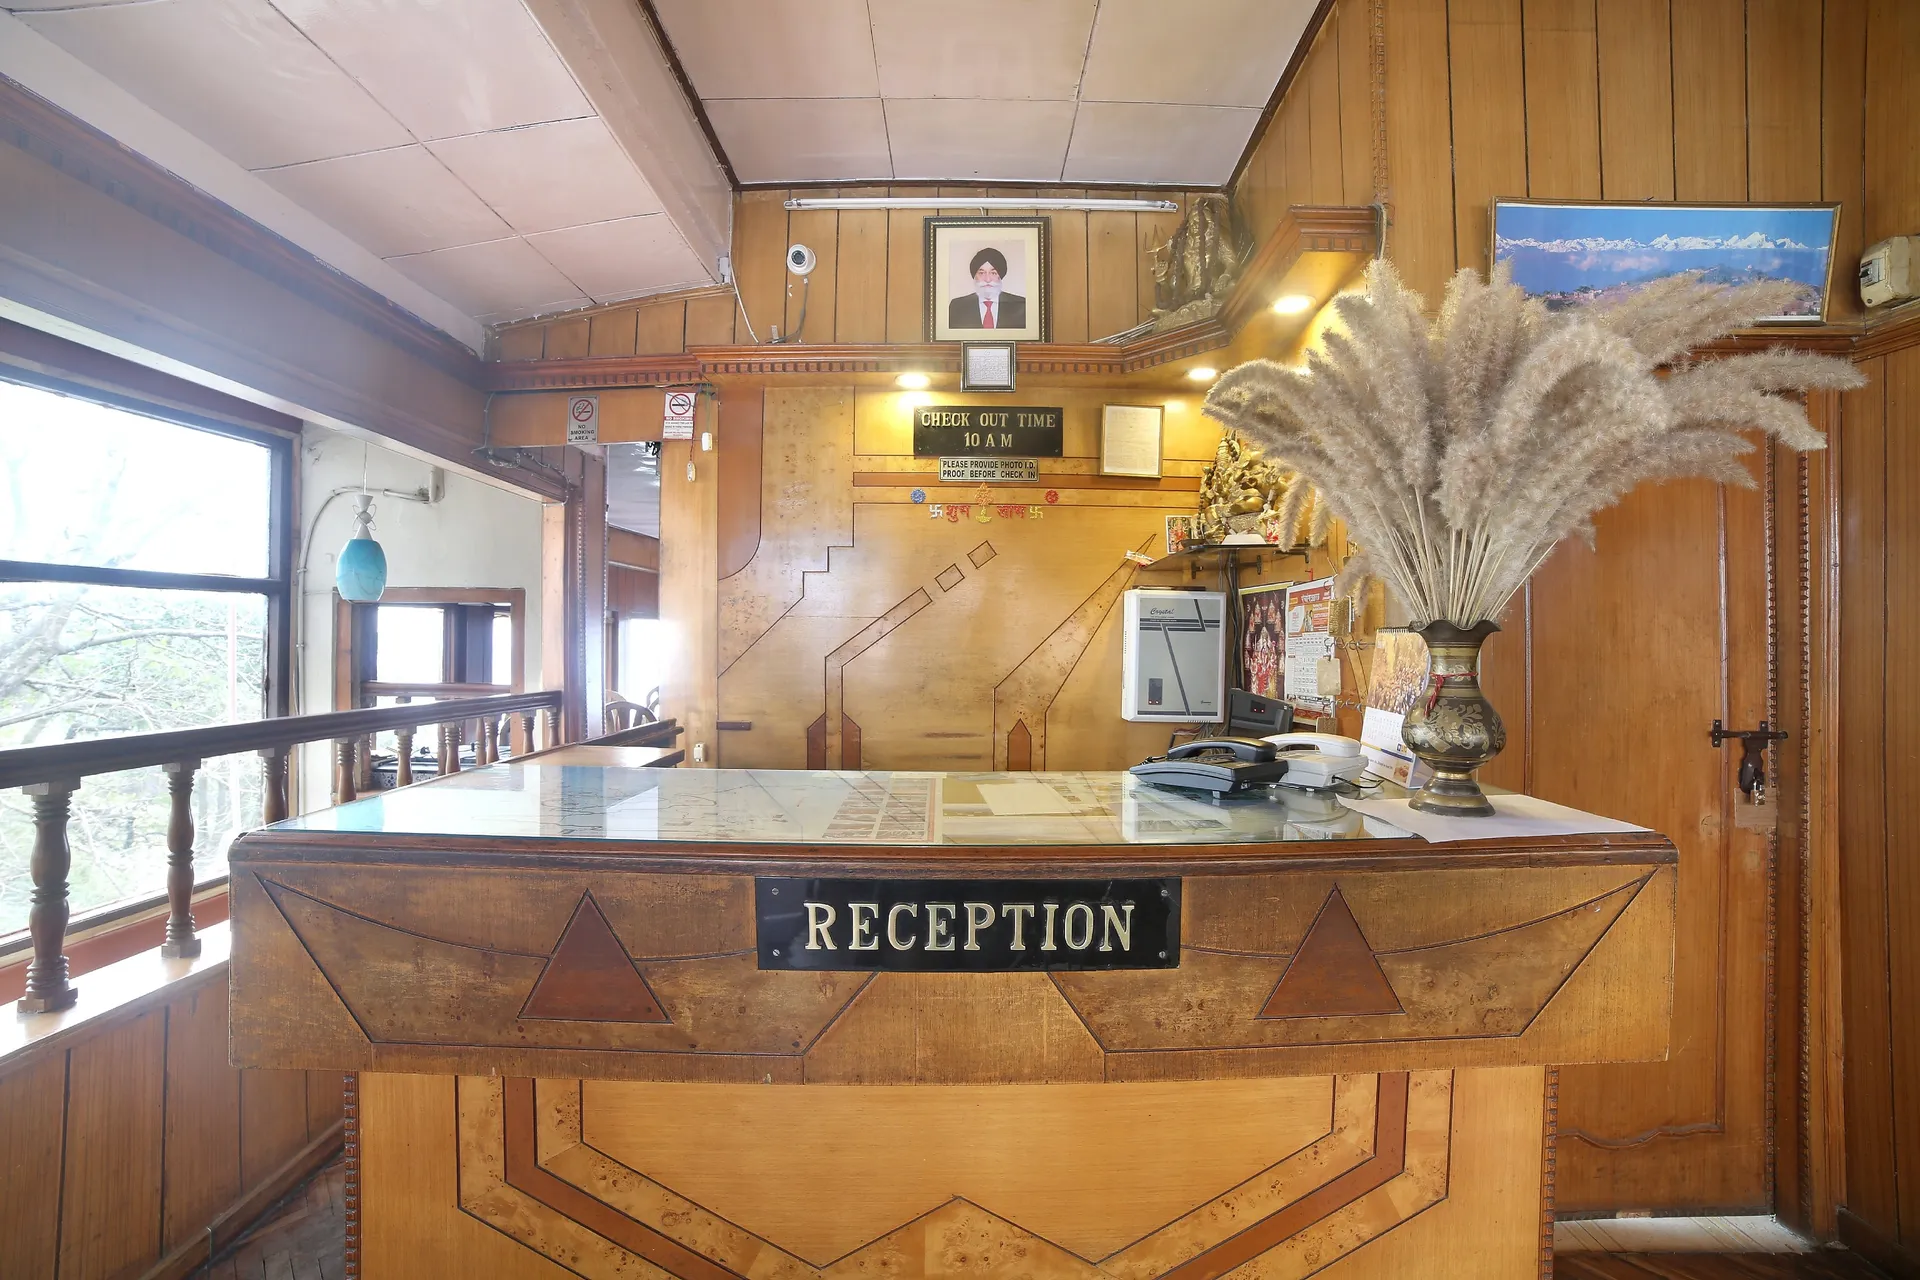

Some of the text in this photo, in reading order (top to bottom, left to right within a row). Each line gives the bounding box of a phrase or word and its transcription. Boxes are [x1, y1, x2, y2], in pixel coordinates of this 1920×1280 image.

[921, 412, 1056, 428] CHECK OUT TIME
[964, 432, 981, 447] 10
[942, 460, 1036, 470] PLEASE PROVIDE PHOTO I.D.
[969, 471, 996, 479] BEFORE
[1000, 471, 1024, 479] CHECK
[1027, 471, 1036, 479] IN
[803, 901, 1136, 953] RECEPTION
